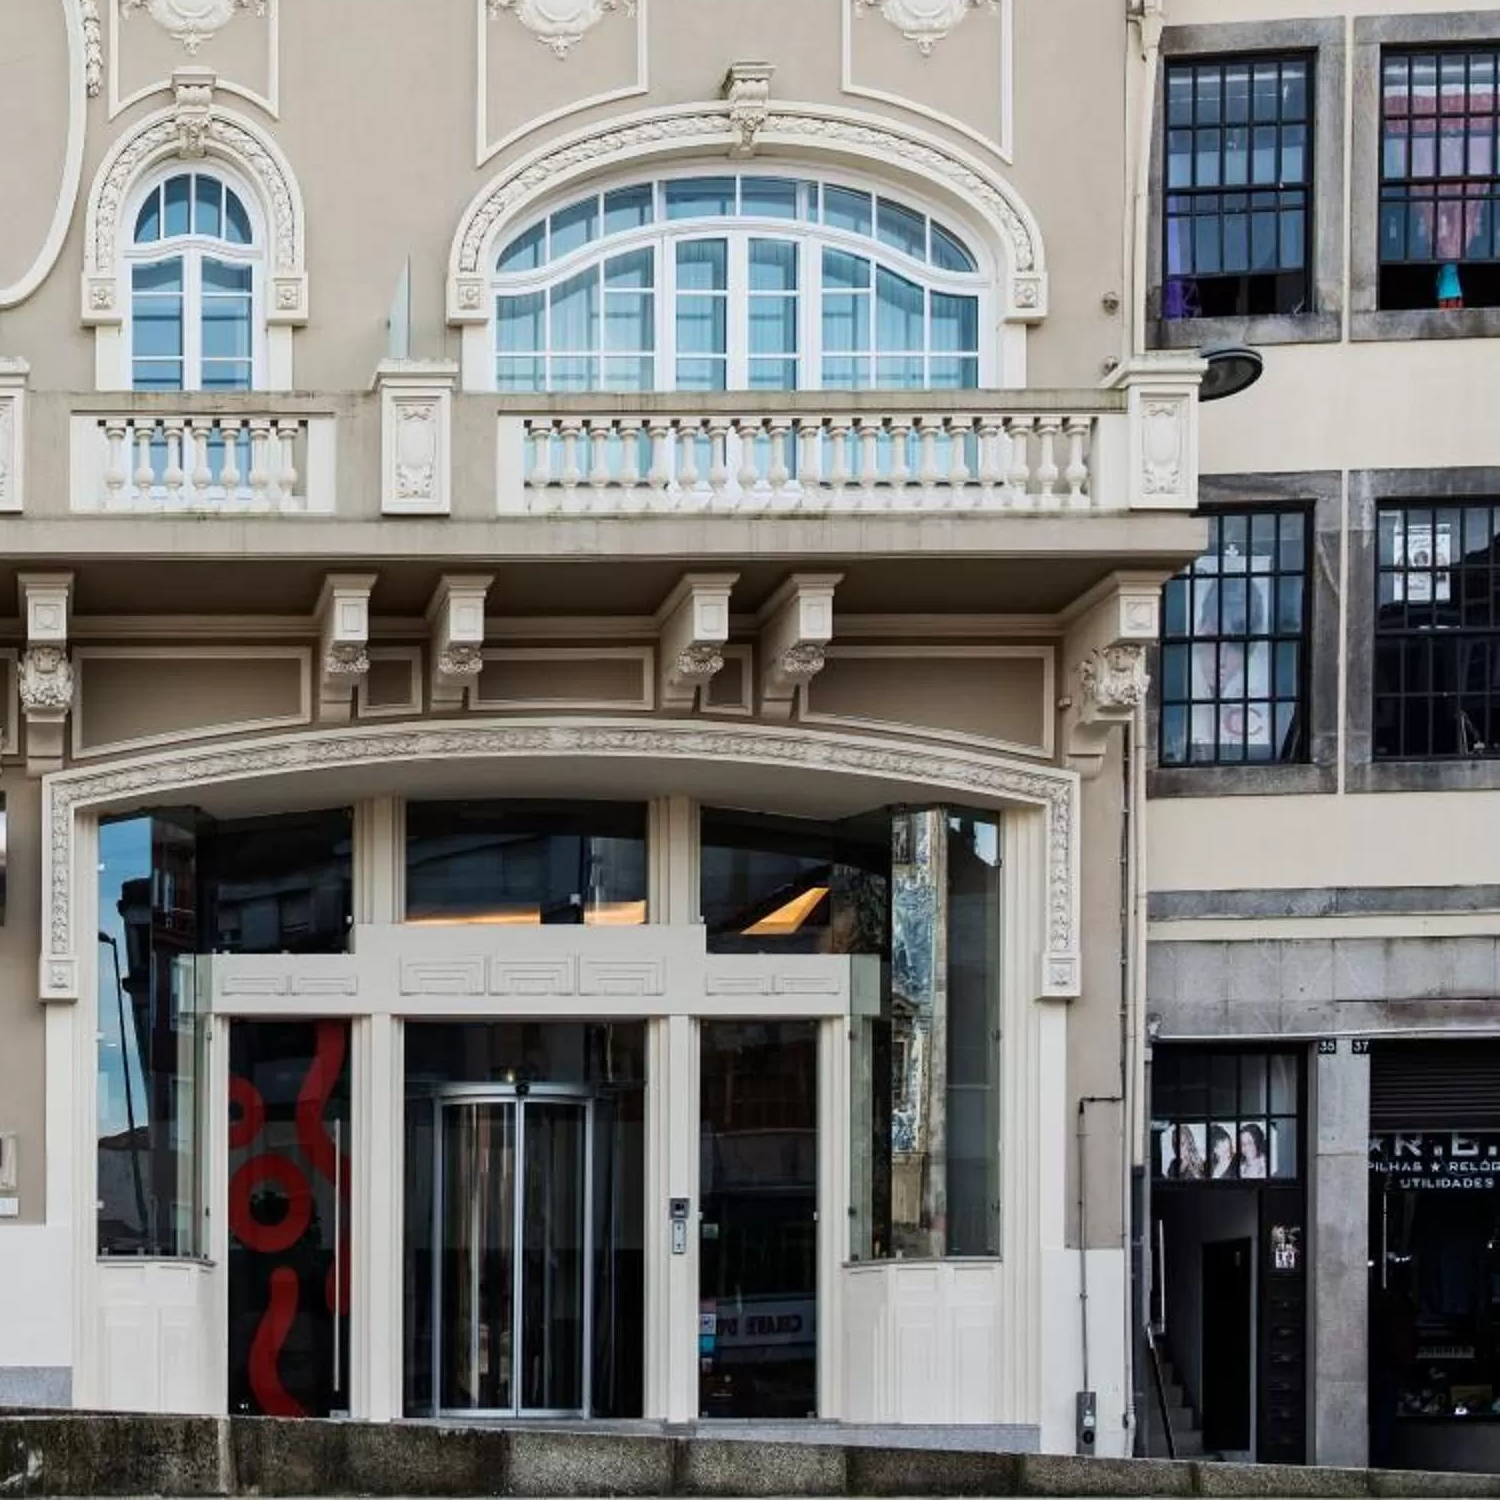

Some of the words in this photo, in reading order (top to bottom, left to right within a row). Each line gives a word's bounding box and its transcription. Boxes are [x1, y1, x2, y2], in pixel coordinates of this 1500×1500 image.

[1354, 1041, 1369, 1052] 37
[1366, 1161, 1422, 1173] PILHAS
[1400, 1177, 1494, 1189] UTILIDADES
